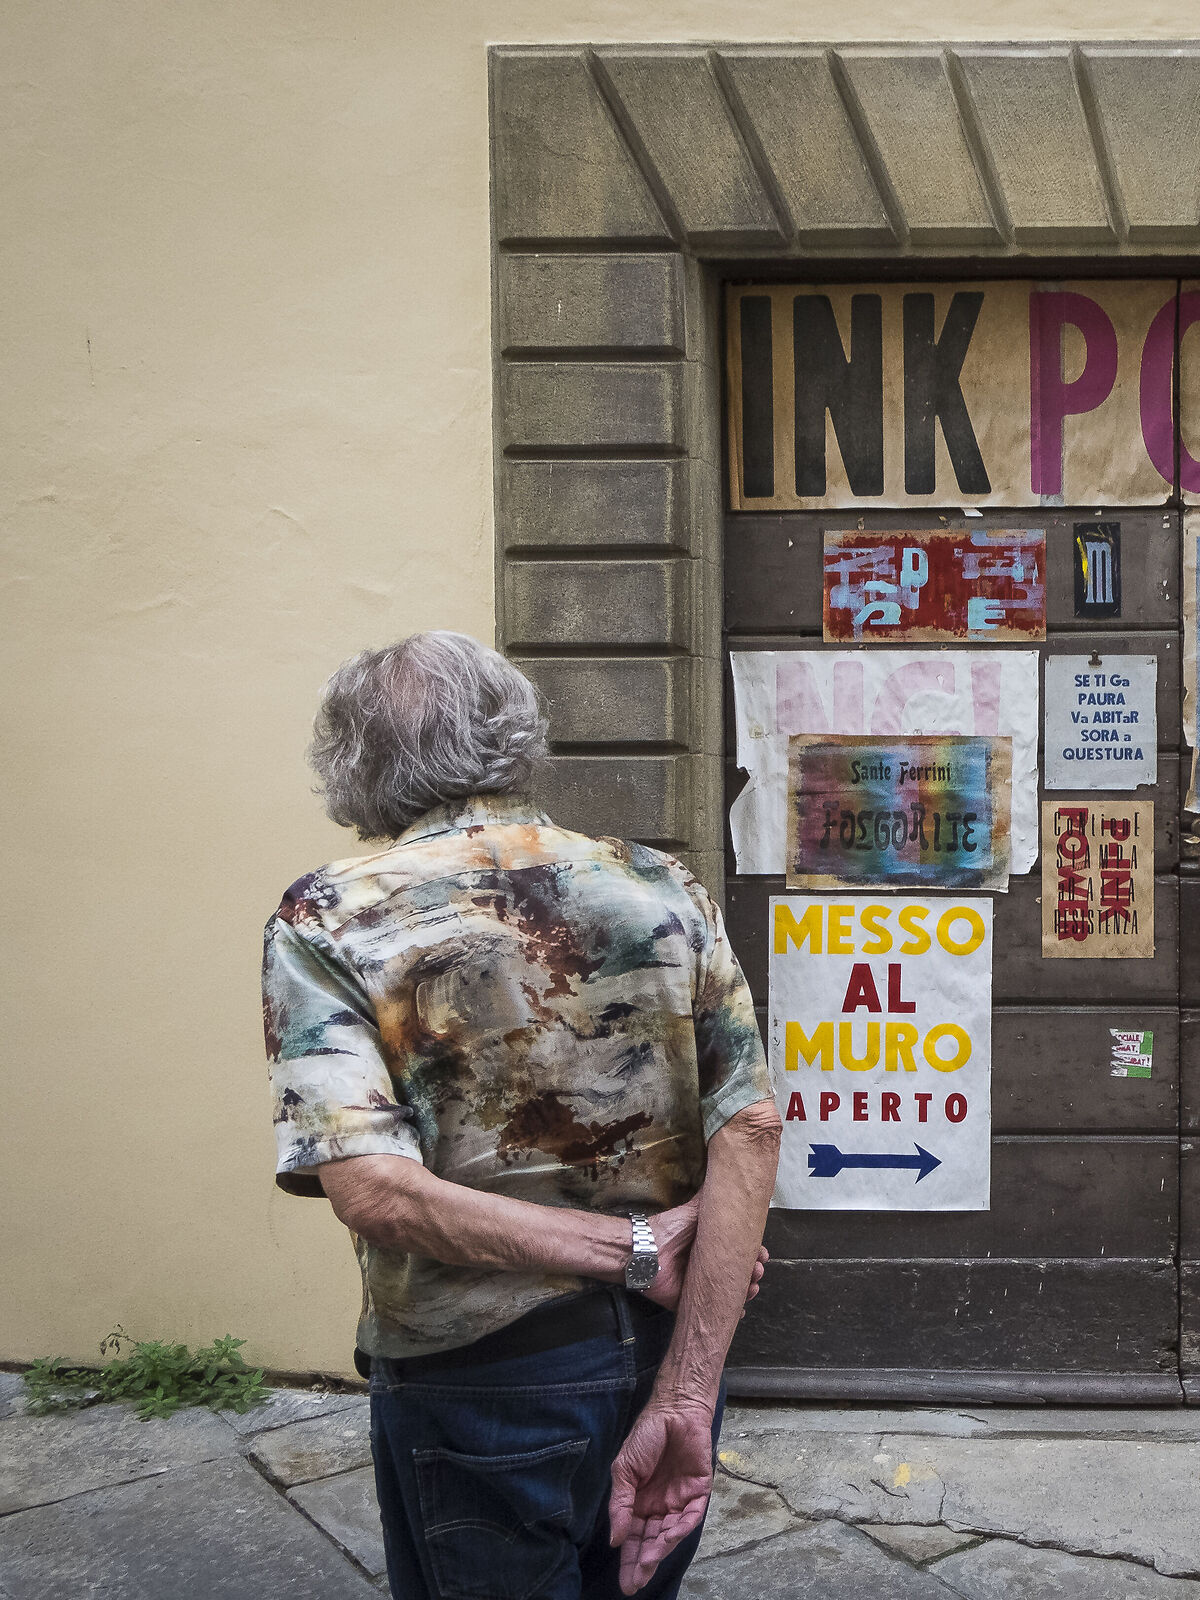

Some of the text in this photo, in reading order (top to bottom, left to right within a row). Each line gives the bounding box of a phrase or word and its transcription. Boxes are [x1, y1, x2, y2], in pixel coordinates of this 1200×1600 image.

[740, 292, 992, 498] INK
[1075, 674, 1130, 687] SE TI Ga
[1078, 693, 1126, 706] PAURA
[1071, 711, 1139, 724] Va ABITaR
[1081, 729, 1119, 741] SORA
[1062, 748, 1144, 760] QUESTURA
[851, 761, 952, 785] Sante Ferrini
[774, 904, 986, 956] MESSO
[841, 963, 916, 1013] AL
[784, 1021, 973, 1072] MURO
[785, 1092, 968, 1123] APERTO
